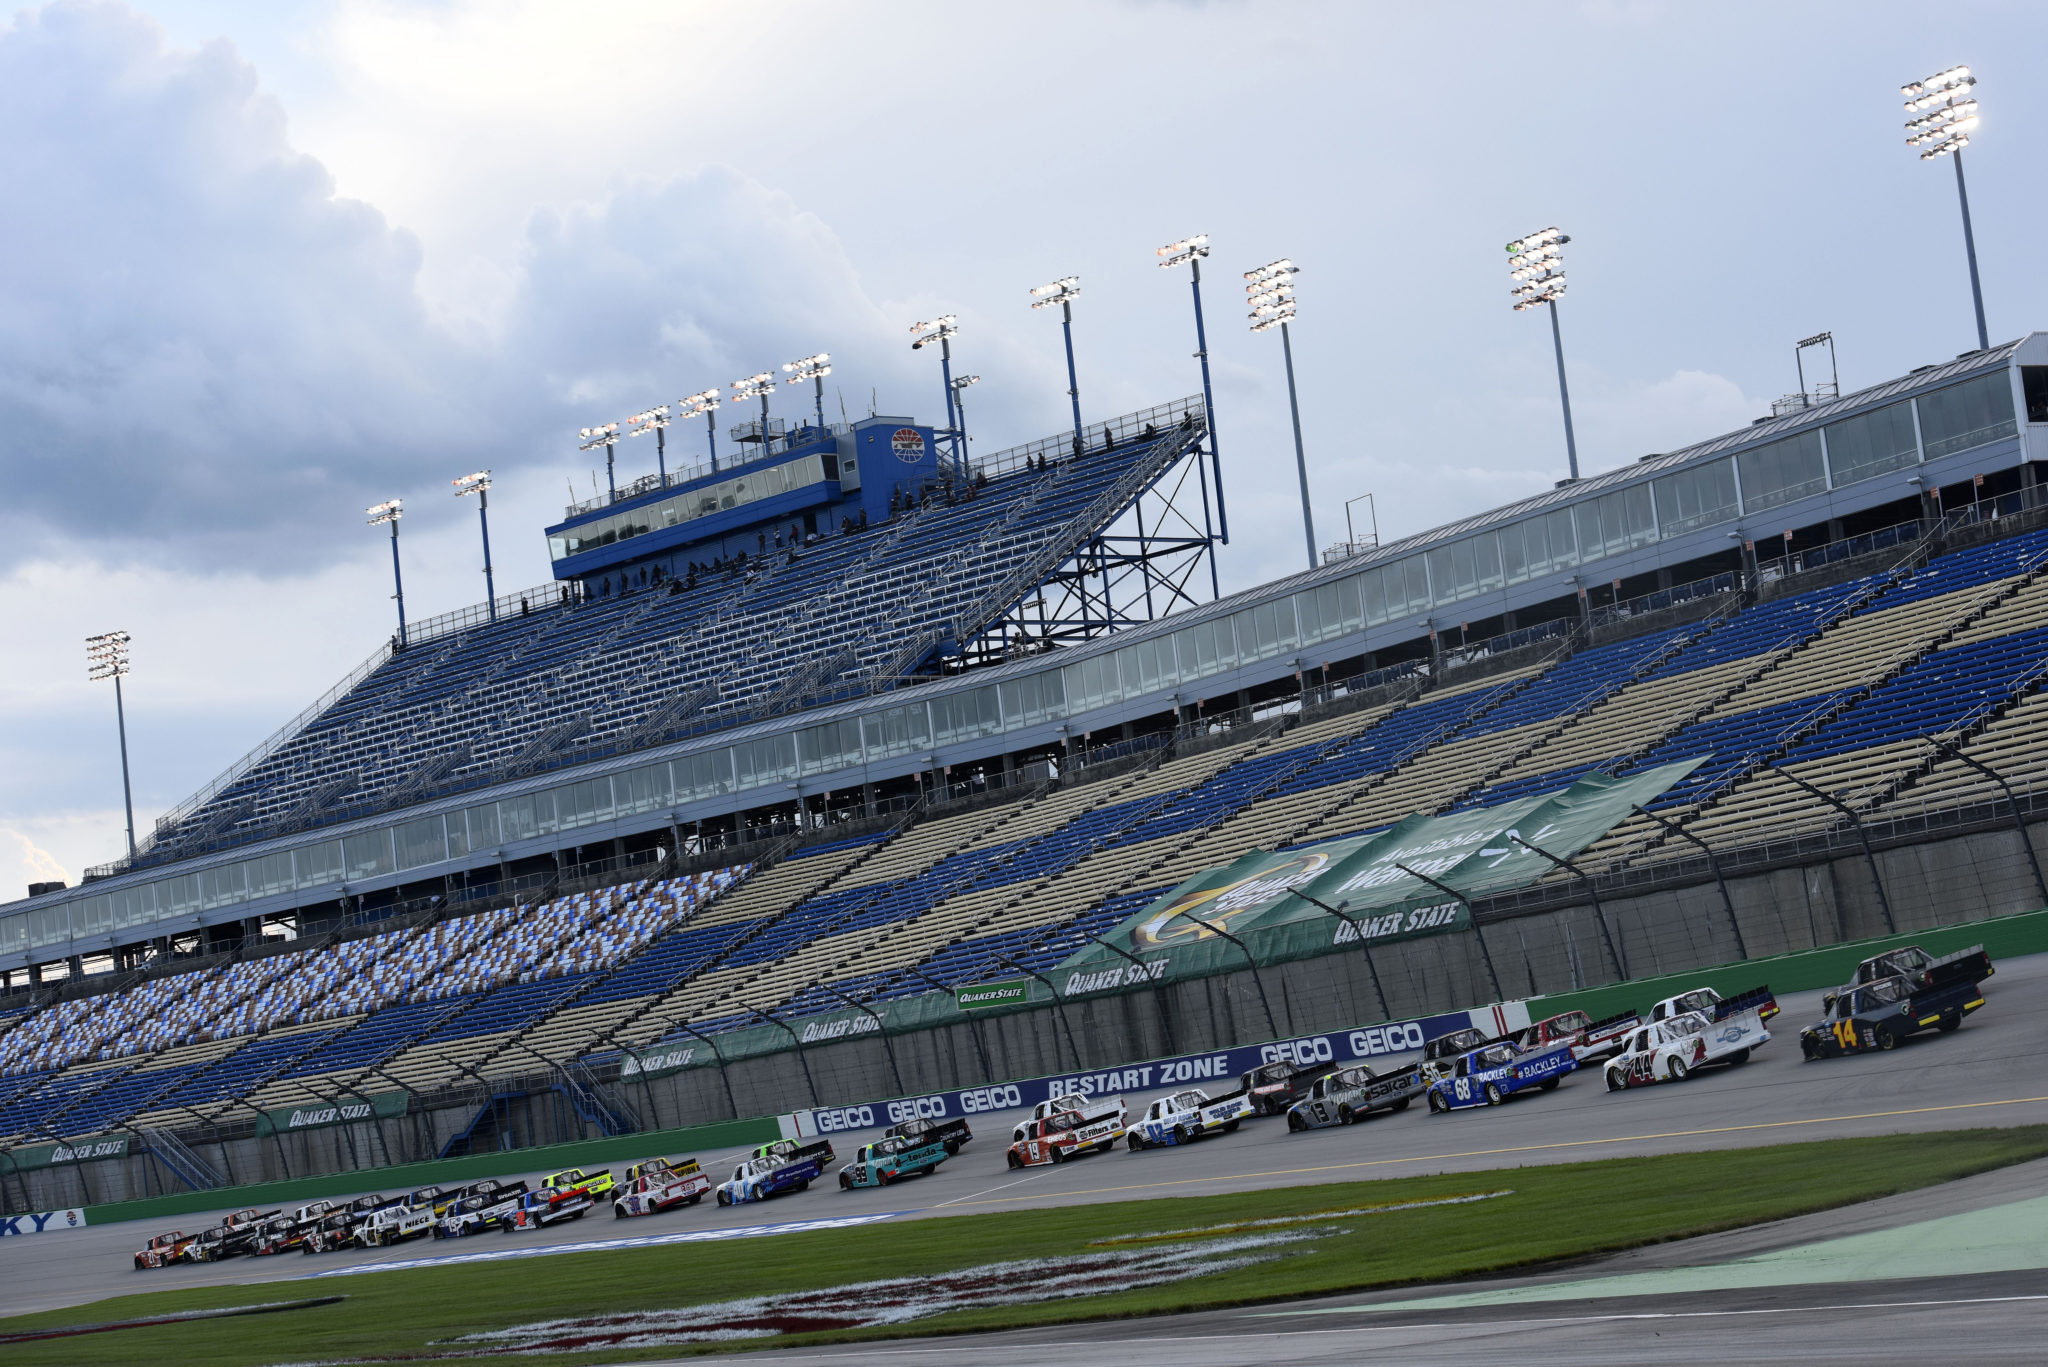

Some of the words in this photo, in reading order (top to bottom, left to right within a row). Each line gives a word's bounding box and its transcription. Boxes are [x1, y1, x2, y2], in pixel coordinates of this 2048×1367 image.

[1370, 829, 1483, 867] Available
[1216, 867, 1332, 902] QUAKER
[1334, 851, 1477, 894] Walma
[1200, 887, 1288, 916] STATE
[1333, 912, 1404, 945] QUAKER
[1404, 901, 1461, 932] STATE
[1064, 971, 1124, 996] QUAKER
[1123, 958, 1170, 986] STATE
[960, 991, 997, 1003] QUAKER
[996, 988, 1023, 999] STATE
[802, 1019, 850, 1044] QUAKER
[1349, 1022, 1425, 1057] GEICO
[1833, 1018, 1857, 1049] 14
[624, 1056, 665, 1076] QUAKER
[663, 1048, 695, 1069] STATE
[1261, 1036, 1333, 1066] GEICO
[1048, 1066, 1153, 1099] RESTART
[1160, 1055, 1228, 1084] ZONE
[1421, 1062, 1442, 1082] 56
[1478, 1067, 1508, 1083] RACKLEY
[1634, 1053, 1654, 1081] 44
[959, 1084, 1022, 1113] GEICO
[1369, 1075, 1411, 1099] sakar
[1454, 1078, 1471, 1101] 68
[289, 1107, 337, 1128] QUAKER
[817, 1104, 875, 1132] GEICO
[887, 1096, 946, 1123] GEICO
[1309, 1102, 1330, 1124] 13
[1087, 1125, 1109, 1137] Filters
[92, 1140, 124, 1157] STATE
[1028, 1142, 1040, 1161] 19
[855, 1166, 868, 1184] 99
[405, 1216, 430, 1229] NIECE
[257, 1237, 266, 1250] 18
